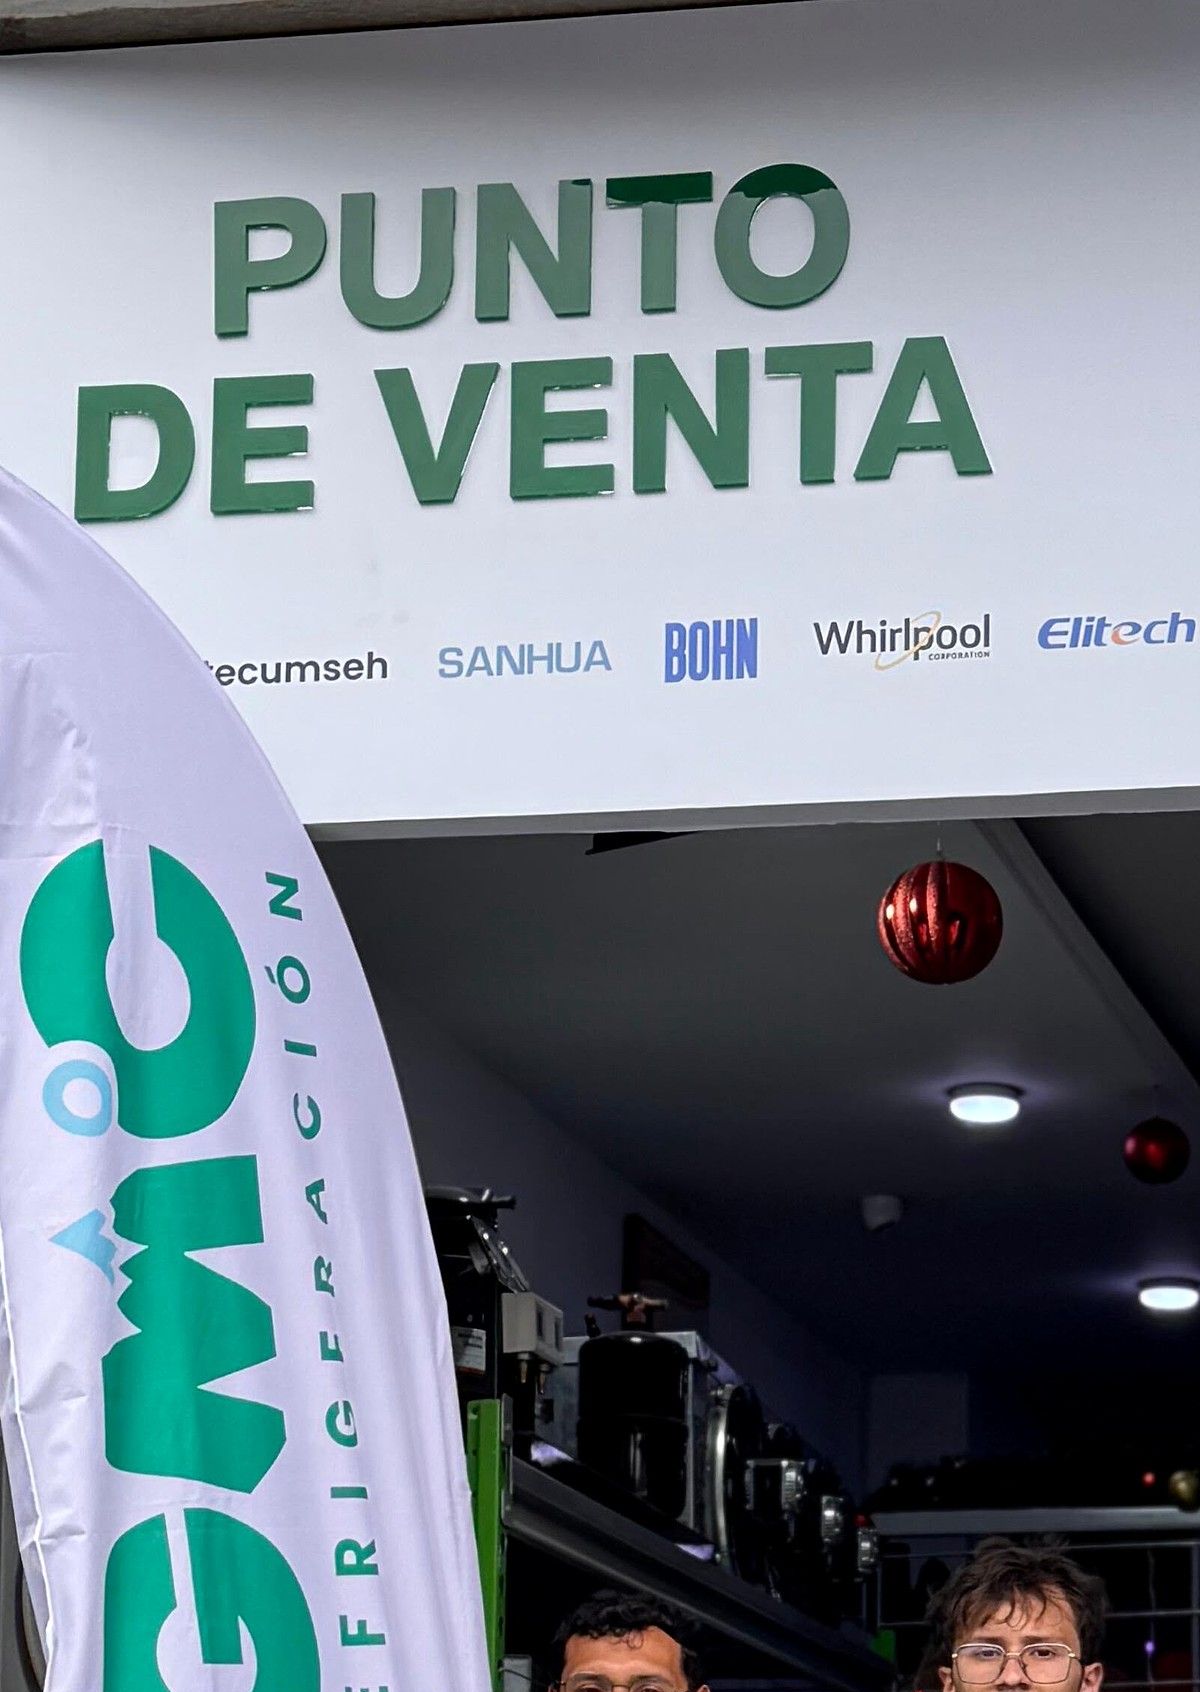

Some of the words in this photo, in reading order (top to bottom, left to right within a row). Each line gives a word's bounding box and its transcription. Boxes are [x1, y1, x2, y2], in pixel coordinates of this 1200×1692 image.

[213, 163, 851, 338] PUNTO
[75, 374, 314, 524] DE
[376, 336, 994, 506] VENTA
[662, 617, 759, 684] BOHN
[813, 613, 991, 662] Whirlpool
[1036, 611, 1198, 650] Elitech
[203, 651, 389, 686] ecumseh
[438, 639, 612, 679] SANHUA
